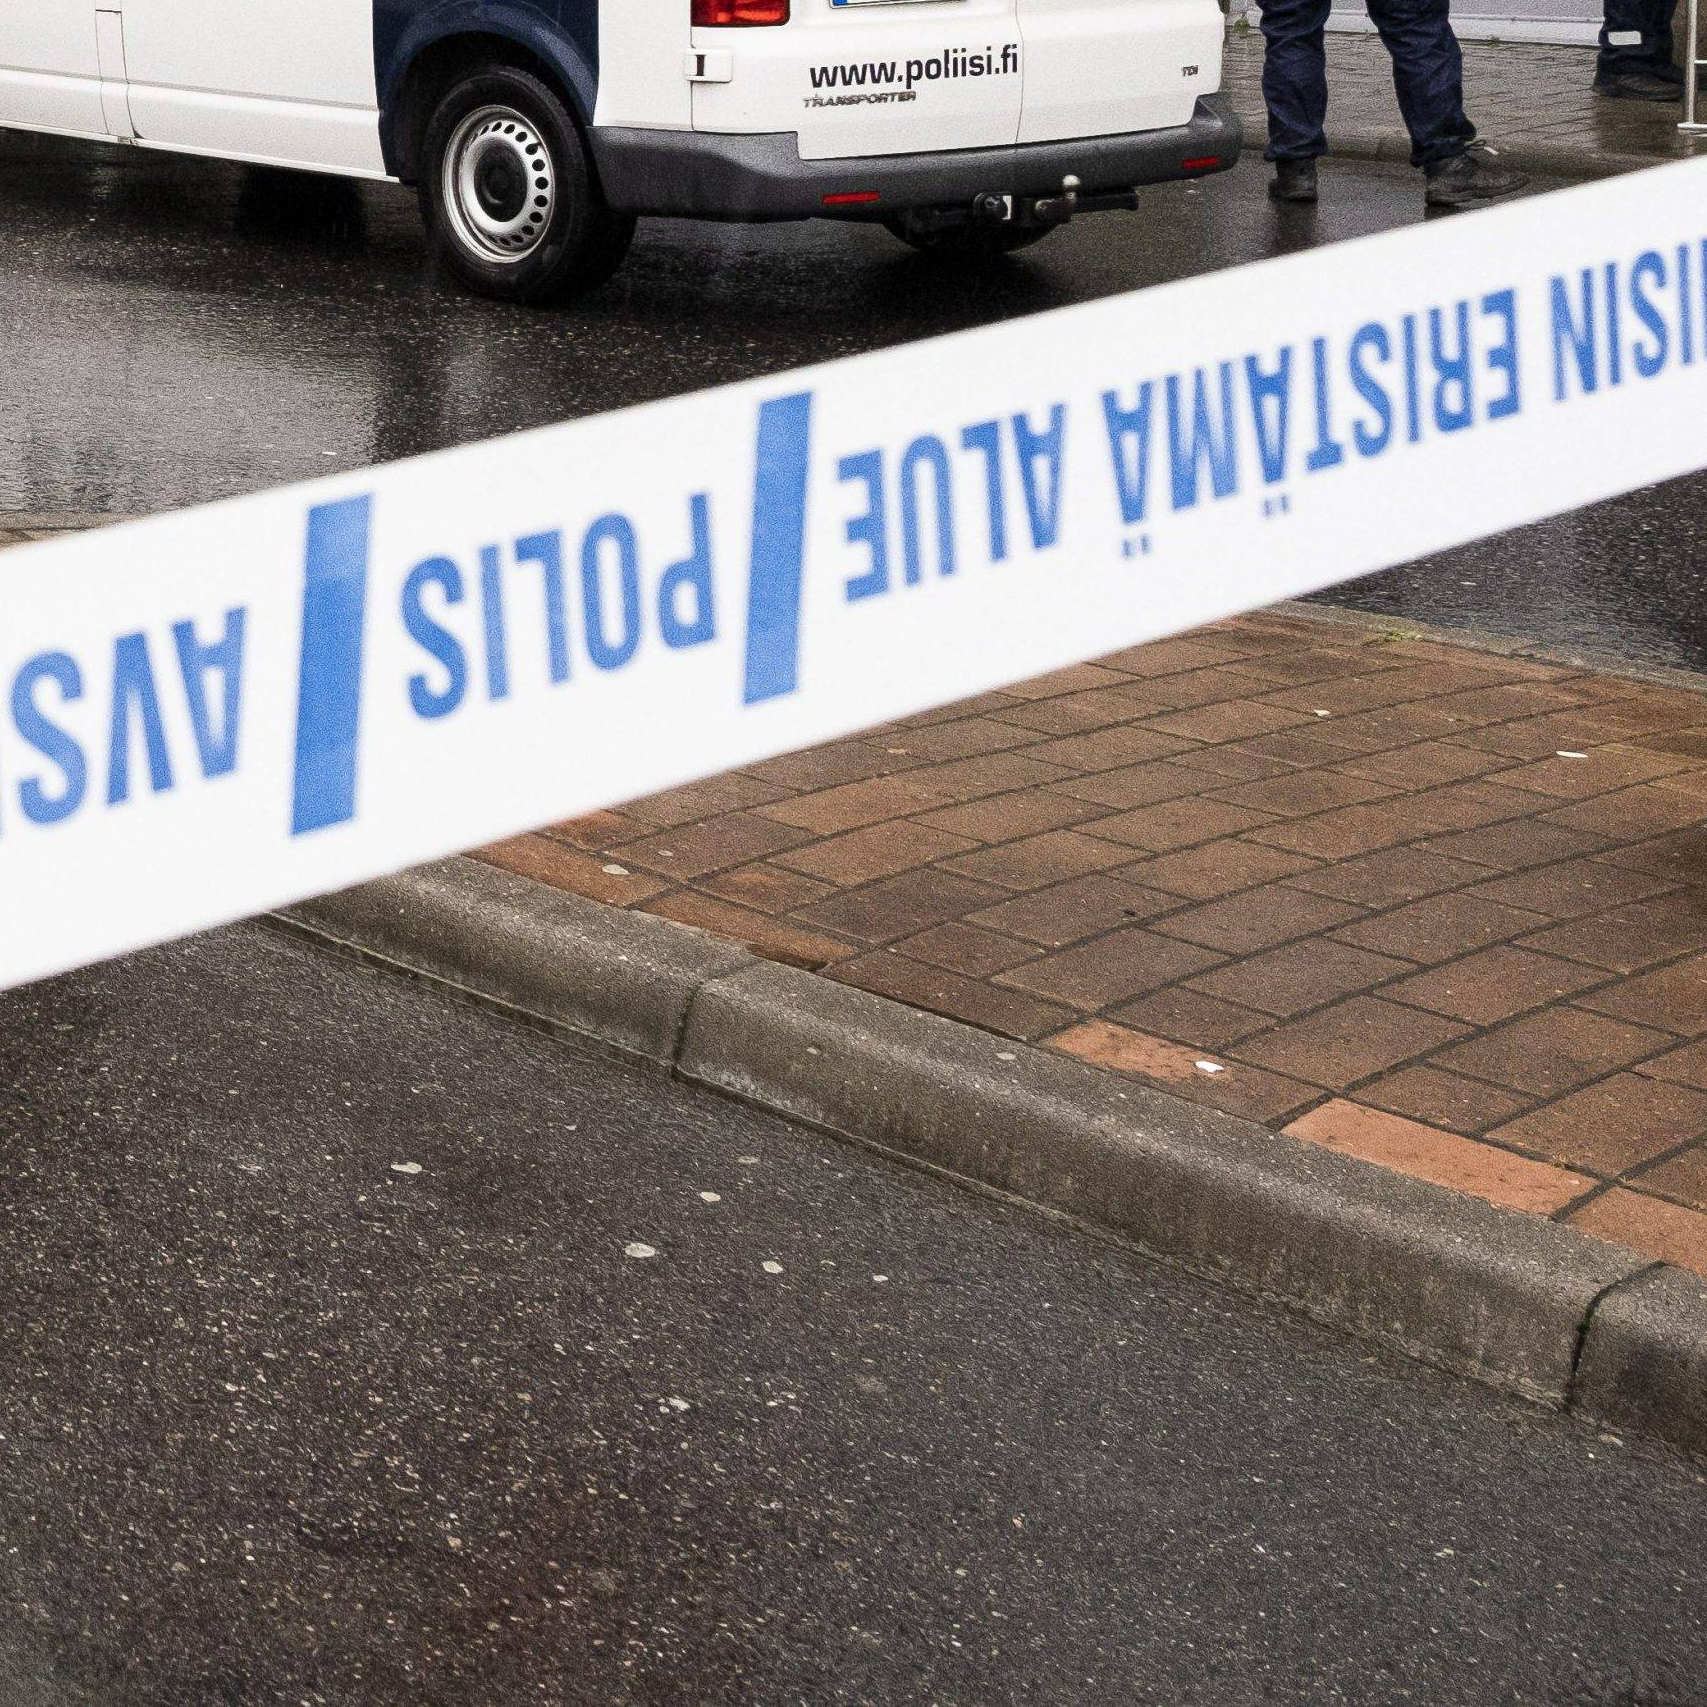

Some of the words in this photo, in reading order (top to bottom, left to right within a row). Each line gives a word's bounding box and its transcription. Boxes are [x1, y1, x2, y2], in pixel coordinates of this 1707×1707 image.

[803, 90, 917, 108] TRANSPORTER
[809, 44, 1018, 89] www.poliisi.fi
[836, 402, 1067, 602] ALUE
[1102, 287, 1523, 557] ERISTÄMÄ
[400, 492, 719, 723] POLIS
